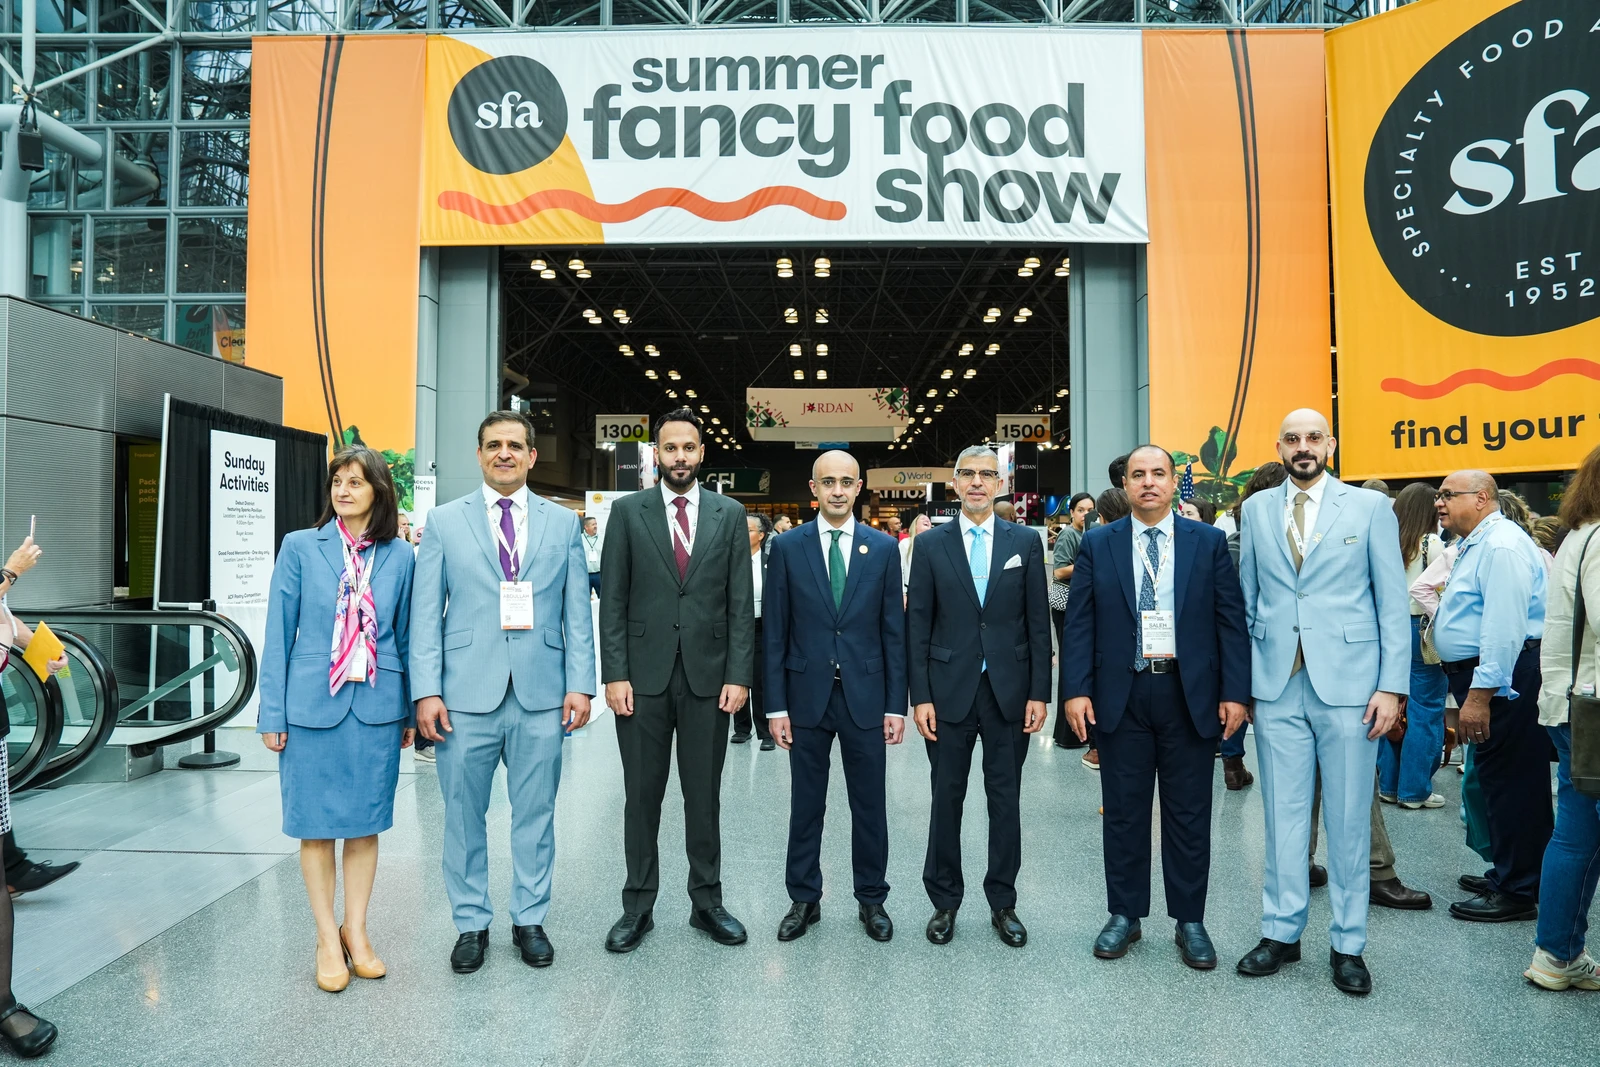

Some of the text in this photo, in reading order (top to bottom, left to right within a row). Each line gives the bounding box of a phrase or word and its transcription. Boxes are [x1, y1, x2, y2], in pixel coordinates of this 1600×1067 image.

[632, 54, 884, 93] summer
[474, 90, 544, 130] sfa
[583, 79, 1085, 178] fancy food
[1394, 19, 1564, 258] SPECIALTY FOOD
[874, 154, 1122, 224] show
[1516, 251, 1582, 280] EST
[1505, 278, 1595, 307] 1952
[220, 336, 245, 348] Clea
[801, 402, 854, 415] JORDAN
[601, 424, 644, 439] 1300
[1001, 424, 1045, 439] 1500
[1390, 414, 1585, 451] find your
[225, 451, 265, 475] Sunday
[906, 472, 932, 480] World
[138, 487, 157, 495] pack
[219, 472, 269, 493] Activities
